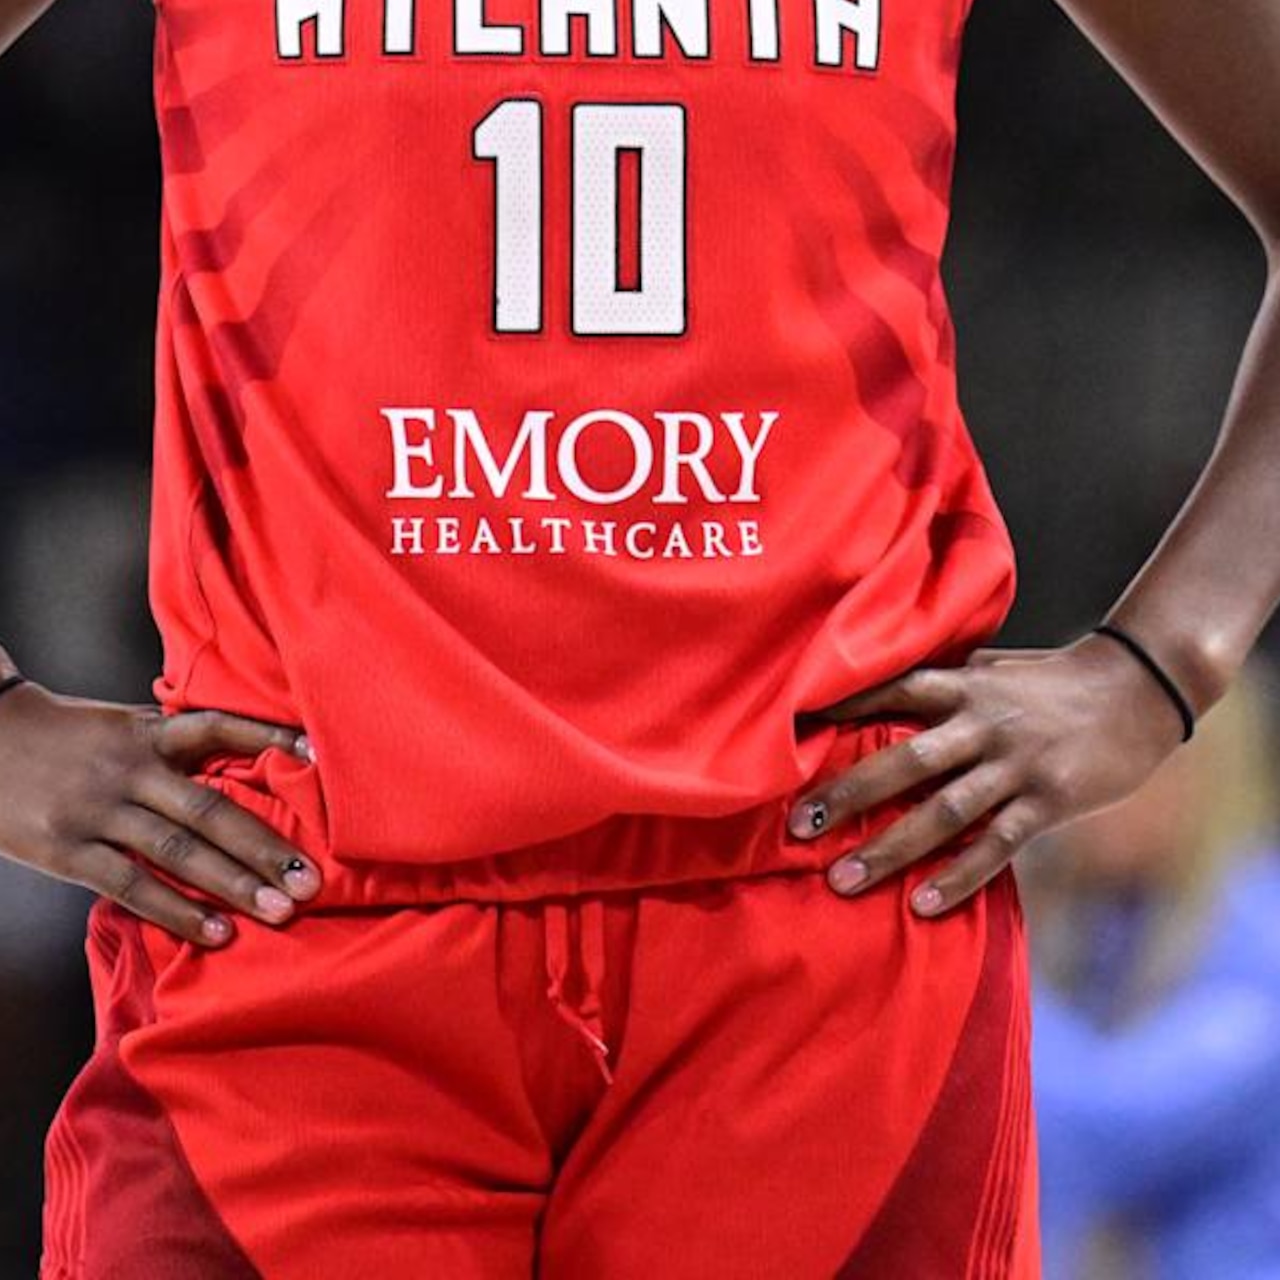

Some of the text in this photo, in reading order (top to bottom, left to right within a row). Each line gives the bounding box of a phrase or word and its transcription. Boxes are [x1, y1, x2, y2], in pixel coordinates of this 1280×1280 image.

[472, 98, 687, 336] 10
[380, 407, 779, 504] EMORY
[390, 517, 765, 559] HEALTHCARE
